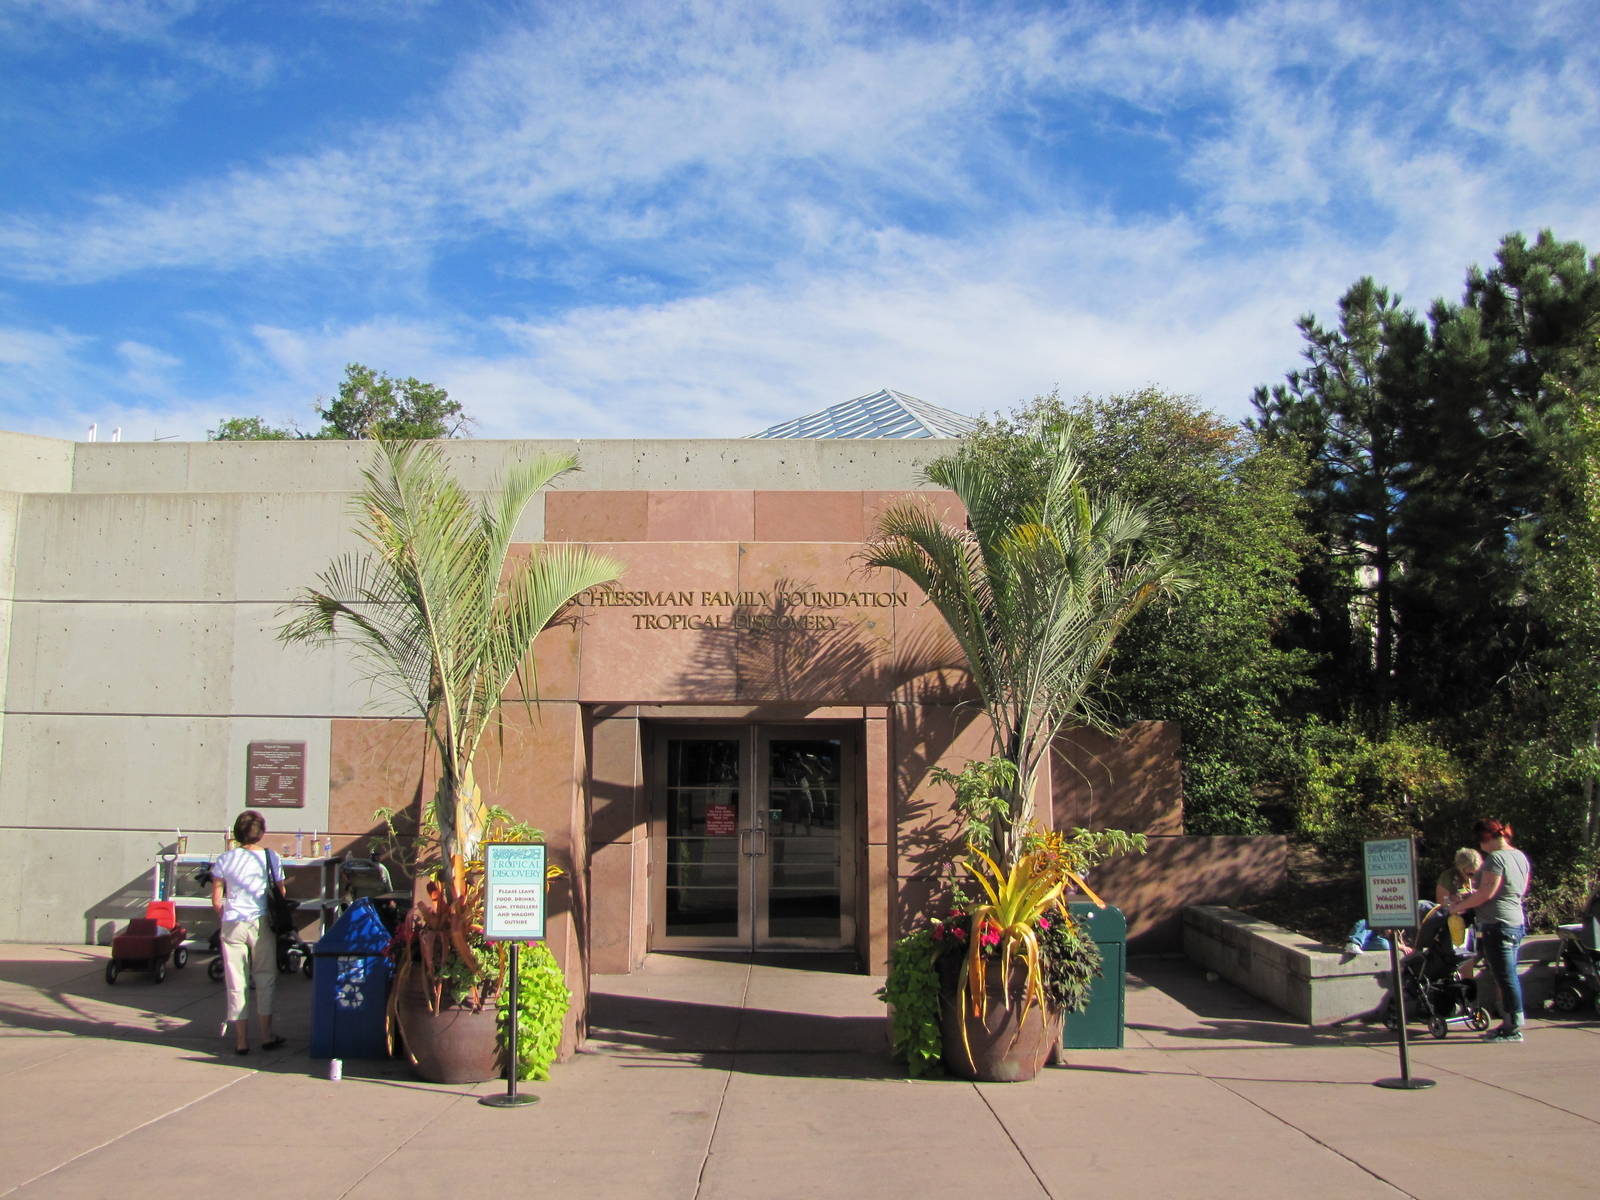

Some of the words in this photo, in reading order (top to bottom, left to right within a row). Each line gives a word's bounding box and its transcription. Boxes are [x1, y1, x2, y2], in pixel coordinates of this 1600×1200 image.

[702, 591, 770, 607] FAMILY
[779, 591, 909, 608] FOUNDATION
[632, 614, 724, 630] TROPICAL
[734, 614, 840, 631] DISCOVERY
[492, 860, 541, 869] TROPICAL
[492, 869, 540, 878] DISCOVERY
[1372, 878, 1406, 886] STROLLER
[1375, 903, 1407, 911] PARKING
